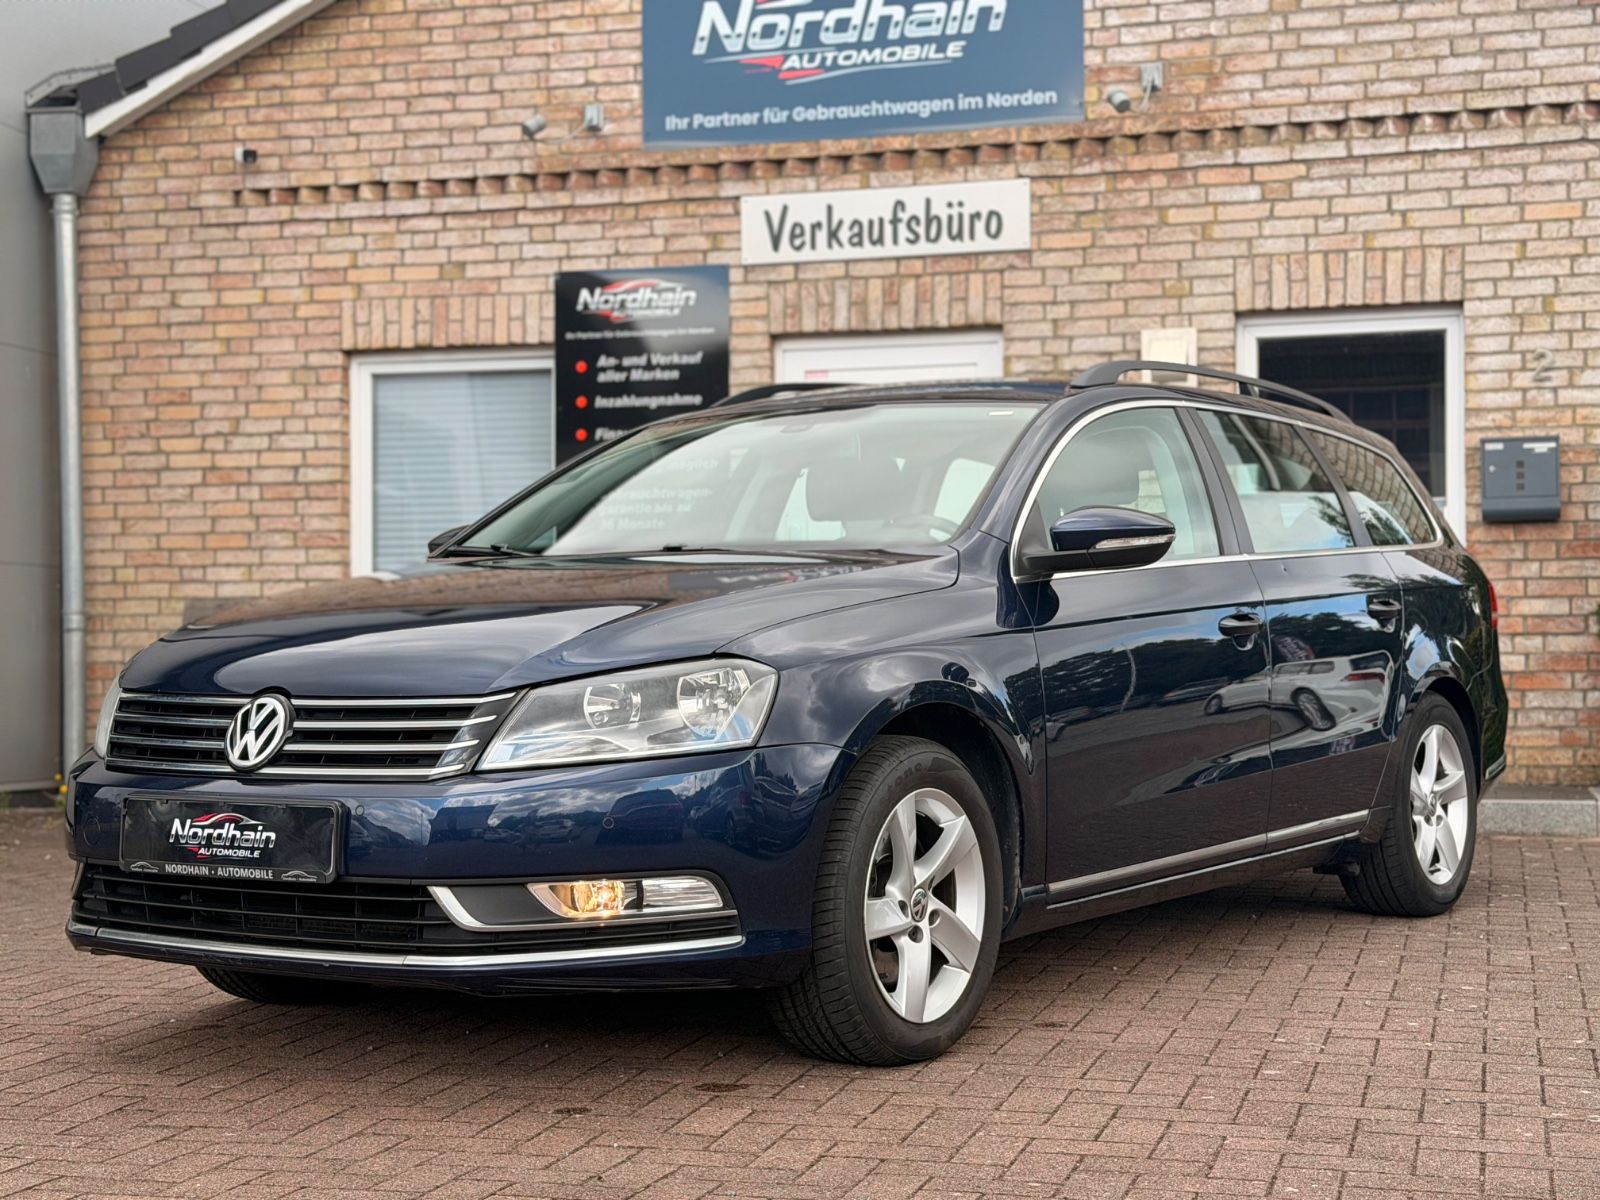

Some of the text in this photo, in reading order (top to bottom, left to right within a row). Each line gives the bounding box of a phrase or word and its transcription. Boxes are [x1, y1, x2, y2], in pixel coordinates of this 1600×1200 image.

[691, 0, 1007, 56] Nordhain
[781, 41, 967, 70] AUTOMOBILE
[665, 89, 1058, 132] Ihr Partner für Gebrauchtwagen im Norden
[764, 197, 1004, 253] Verkaufsbüro
[575, 286, 697, 312] Nordhain
[596, 351, 703, 369] An- und Verkauf
[1532, 349, 1554, 383] 2
[596, 368, 680, 383] aller Marken
[594, 392, 703, 410] Inzahlungnahme
[169, 817, 276, 848] Nordhain
[197, 847, 261, 859] AUTOMOBILE
[165, 863, 209, 876] NORDHAIN
[217, 866, 274, 880] AUTOMOBILE
